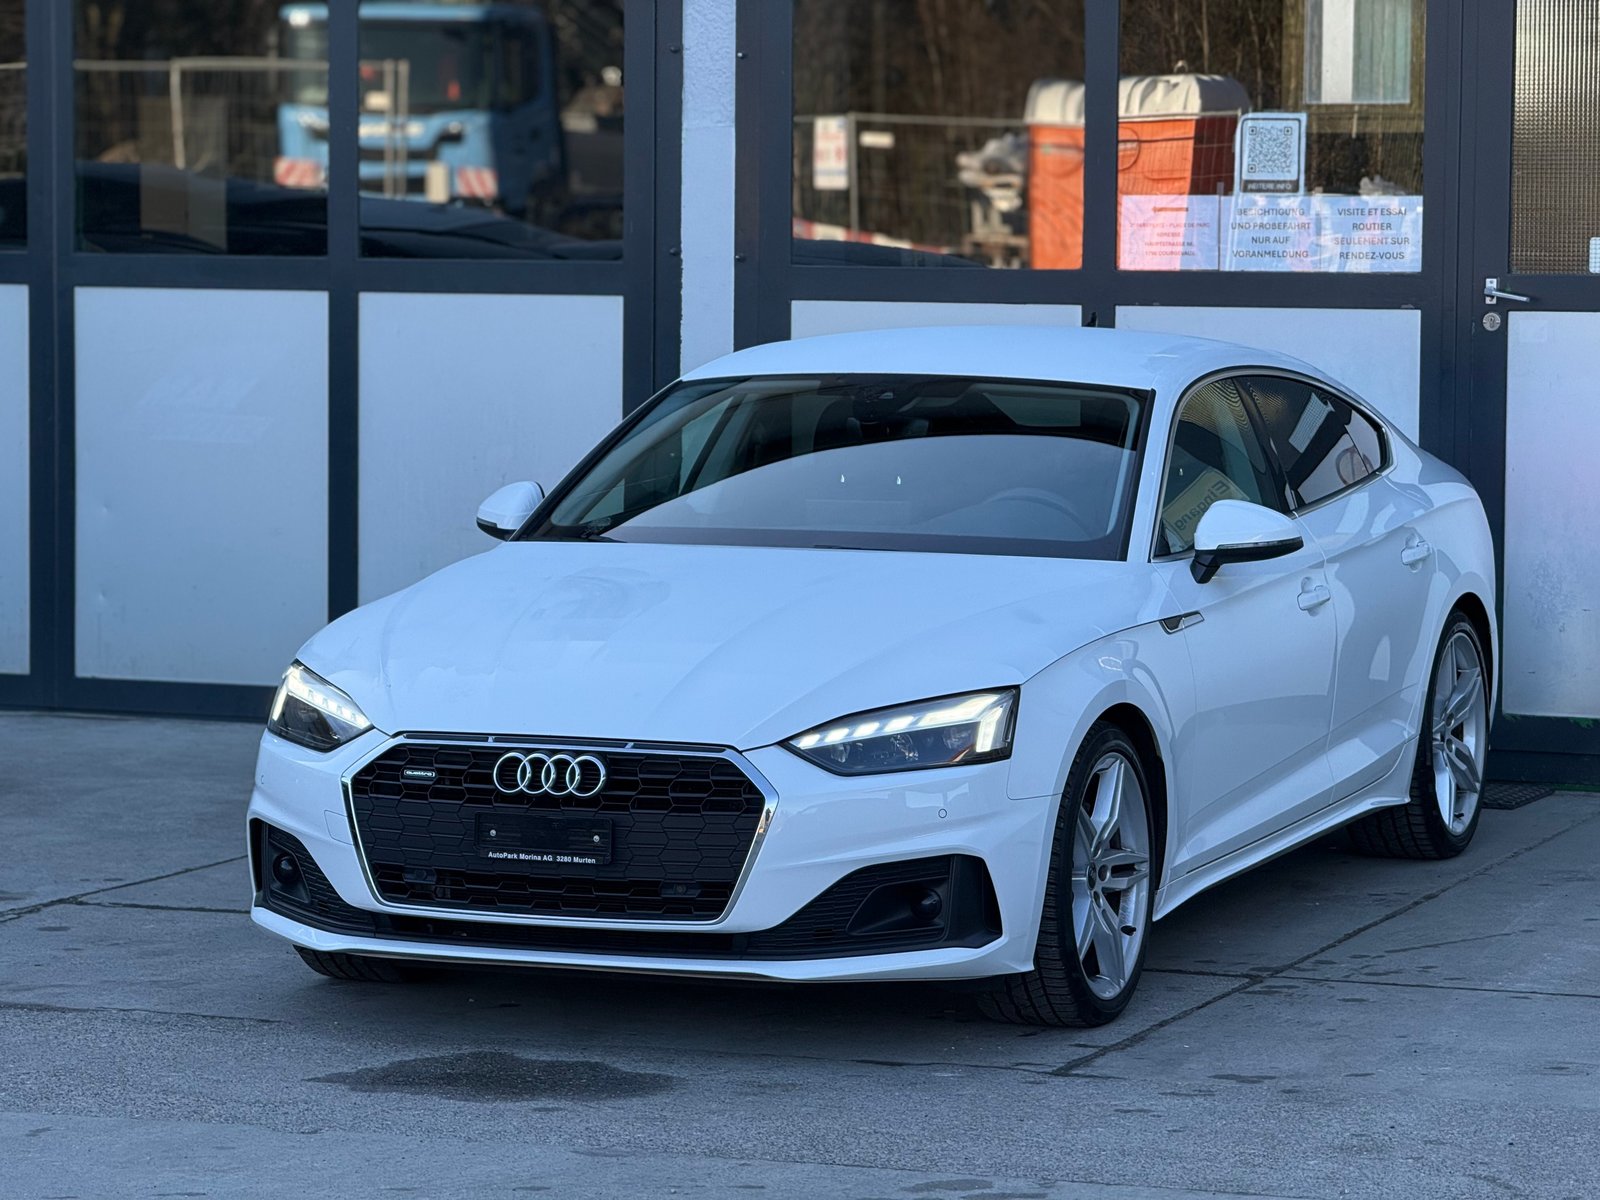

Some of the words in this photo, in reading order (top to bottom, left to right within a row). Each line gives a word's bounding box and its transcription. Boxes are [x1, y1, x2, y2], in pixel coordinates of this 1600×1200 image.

[1237, 208, 1305, 216] BESICHTIGUNG
[1337, 208, 1366, 216] VISITE
[1367, 208, 1378, 216] ET
[1380, 208, 1407, 216] ESSAI
[1231, 222, 1251, 230] UND
[1252, 222, 1311, 230] PROBEFAHRT
[1352, 222, 1393, 231] ROUTIER
[1251, 236, 1271, 244] NUR
[1272, 236, 1291, 244] AUF
[1334, 237, 1389, 245] SEULEMENT
[1390, 237, 1410, 245] SUR
[1232, 250, 1309, 258] VORANMELDUNG
[1339, 251, 1405, 260] RENDEZ-VOUS
[488, 851, 518, 860] AutoPark
[519, 853, 541, 861] Morina
[542, 854, 553, 862] AG
[556, 855, 572, 863] 3280
[573, 856, 596, 864] Murten
